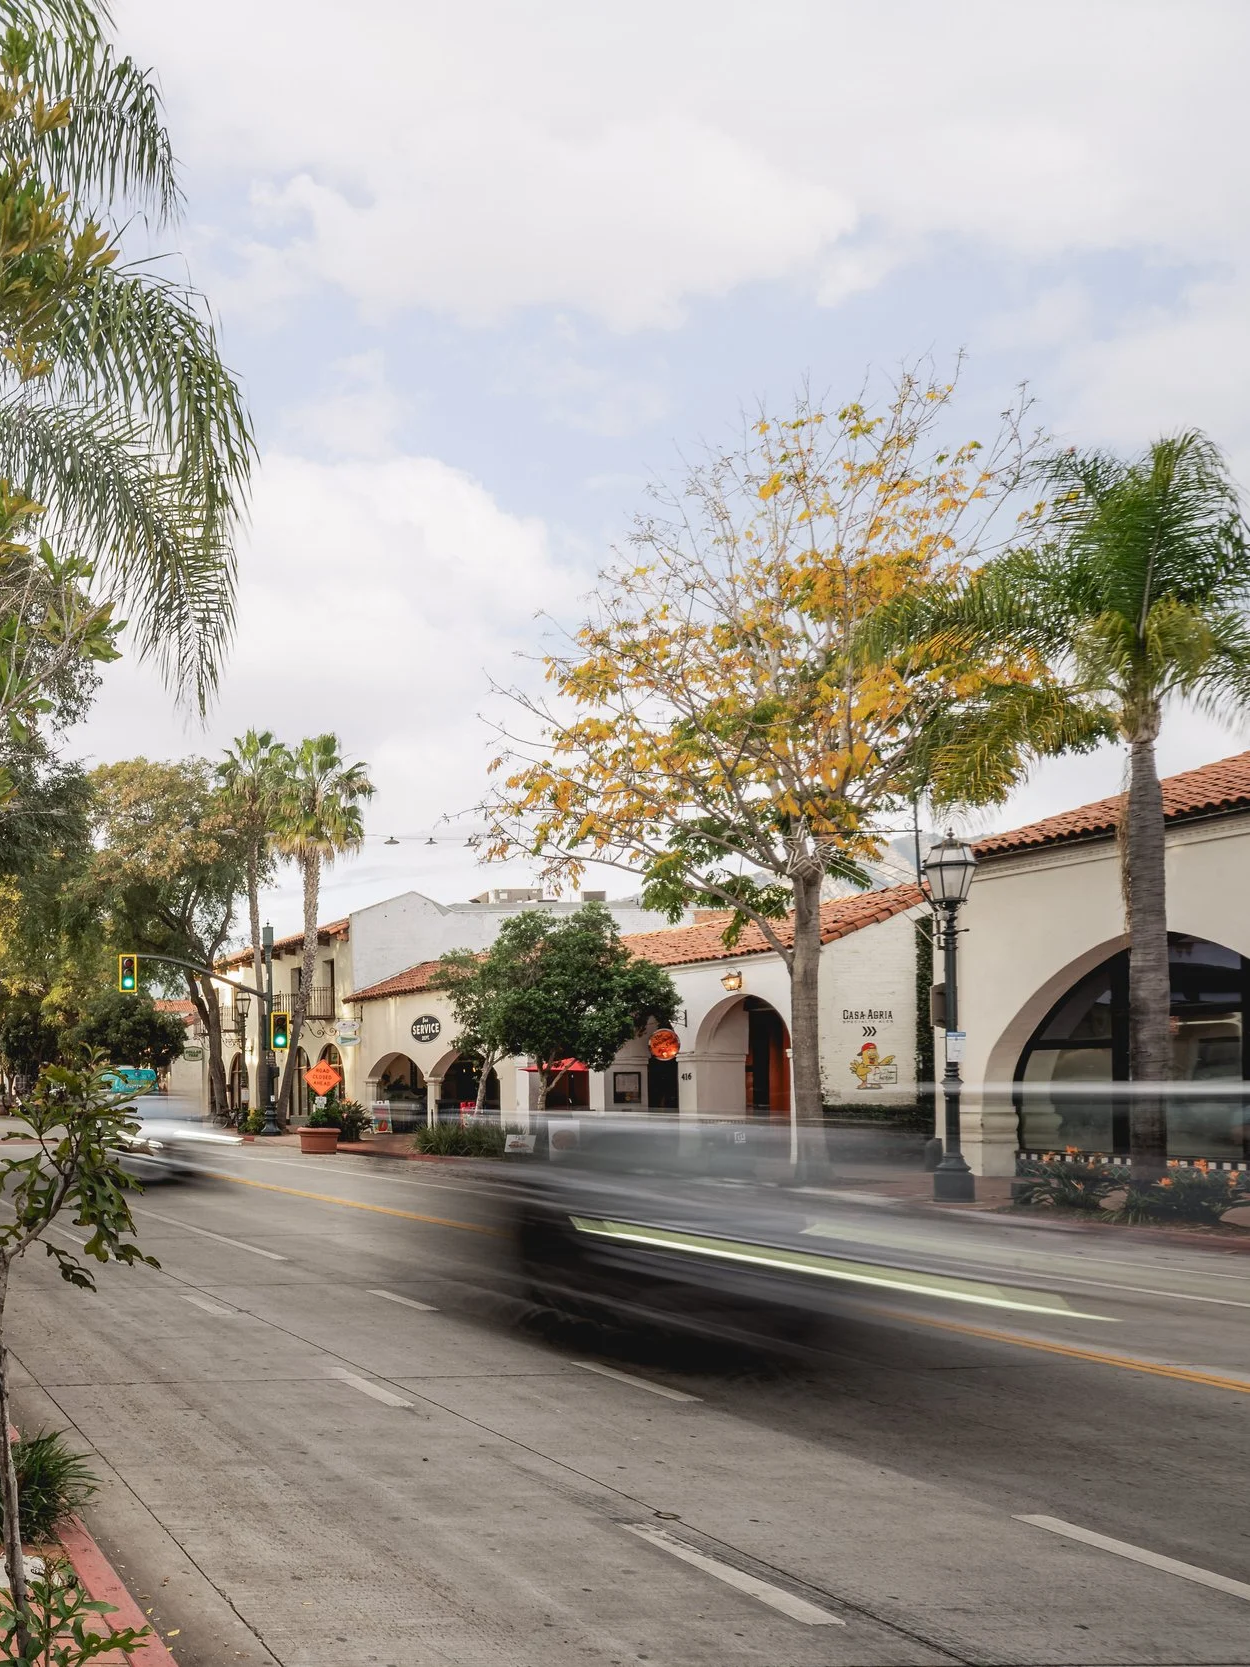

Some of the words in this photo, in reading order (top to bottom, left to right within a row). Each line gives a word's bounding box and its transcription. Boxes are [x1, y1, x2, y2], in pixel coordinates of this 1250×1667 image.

[842, 1009, 866, 1020] CASA
[868, 1009, 893, 1020] AGRIA
[412, 1022, 440, 1036] SERVICE
[681, 1072, 693, 1081] 416
